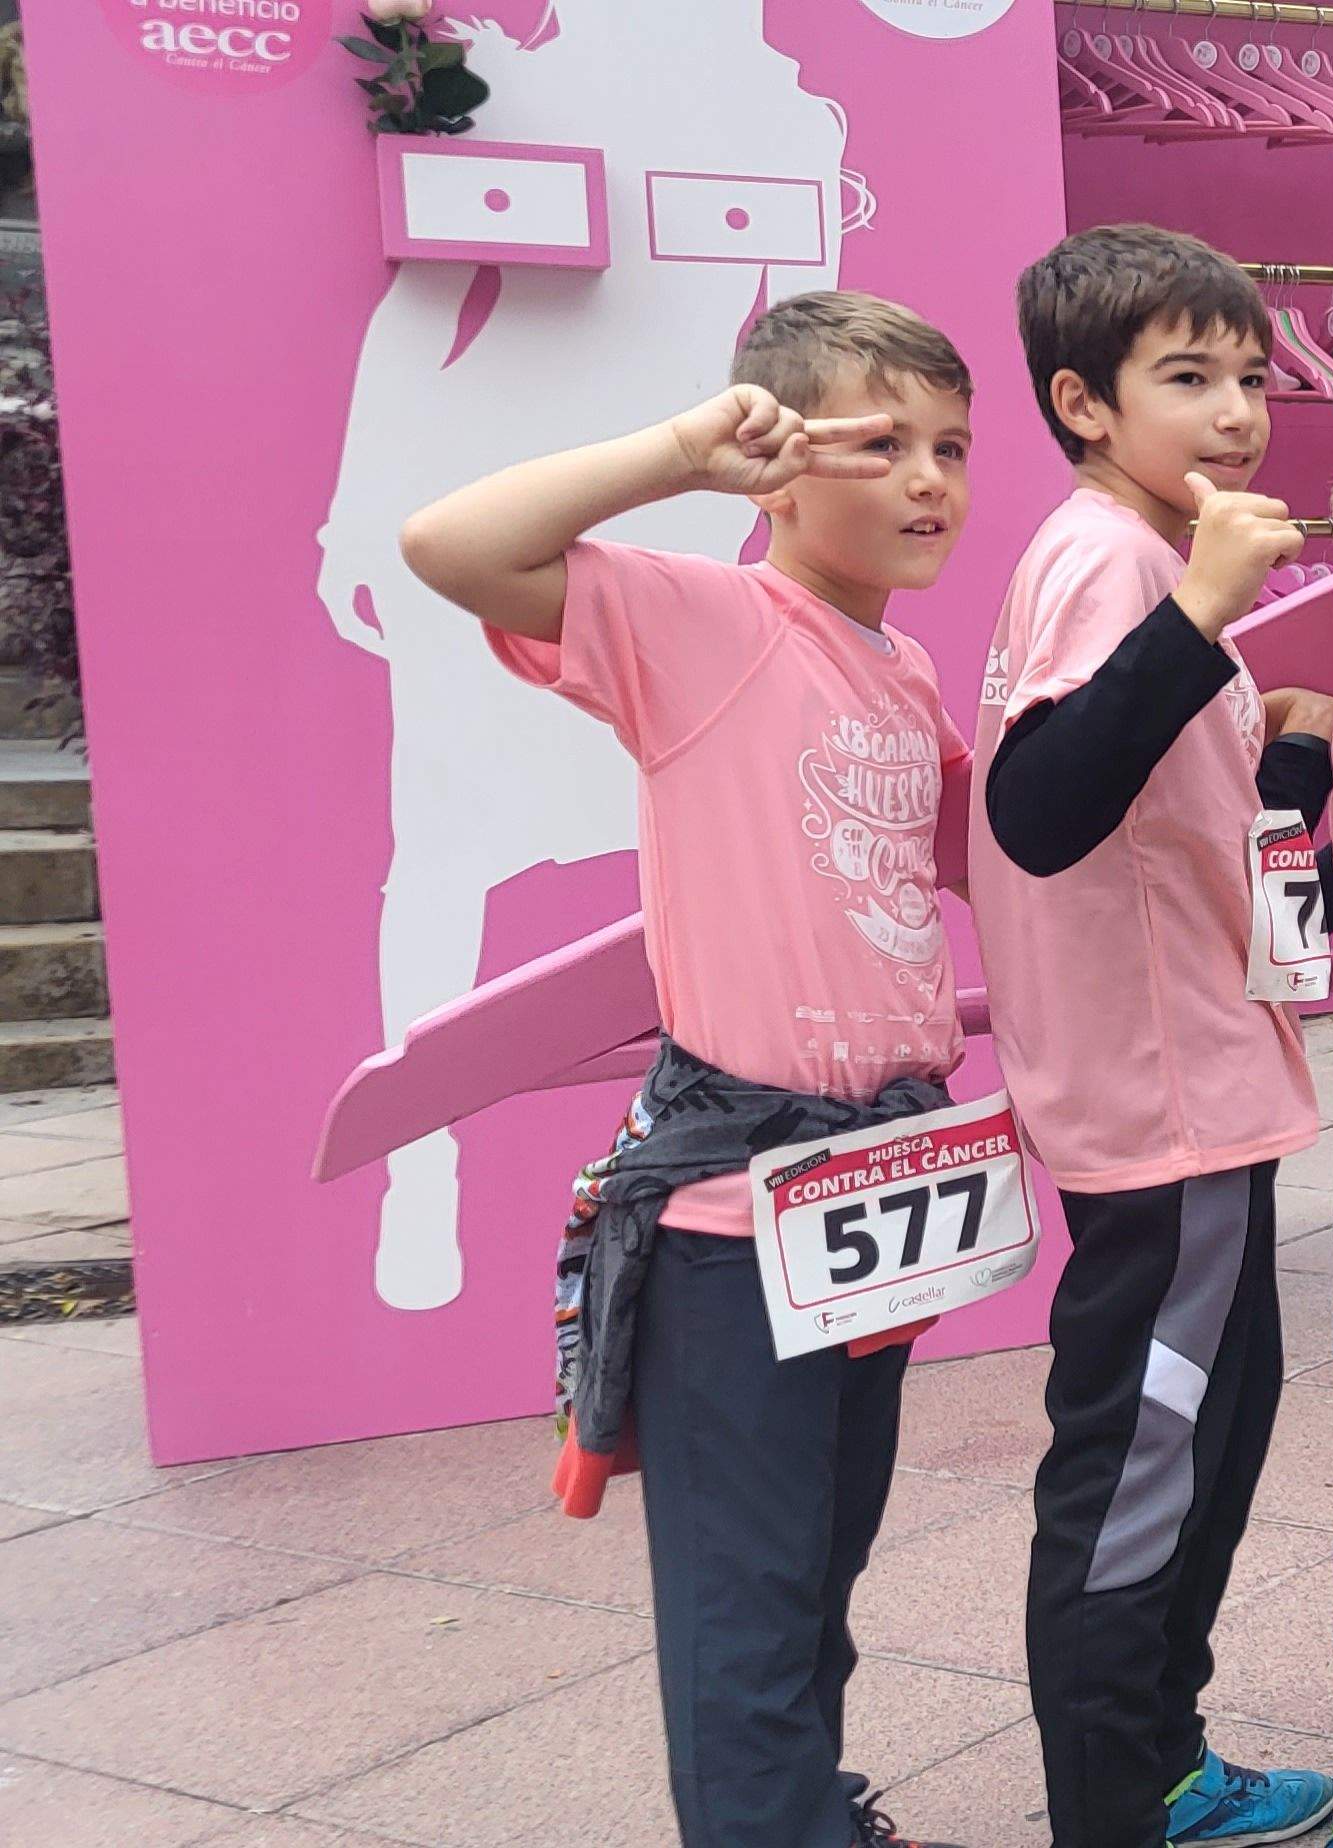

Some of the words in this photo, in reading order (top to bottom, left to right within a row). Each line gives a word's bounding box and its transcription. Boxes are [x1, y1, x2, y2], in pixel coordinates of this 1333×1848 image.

[142, 18, 291, 61] aecc
[1269, 850, 1315, 868] CONT
[868, 1136, 933, 1164] HUESCA
[769, 1175, 784, 1187] VIII
[788, 1166, 884, 1204] CONTRA
[891, 1160, 917, 1178] EL
[922, 1135, 1012, 1171] CÁNCER
[824, 1171, 988, 1285] 577
[901, 1286, 946, 1308] castellar
